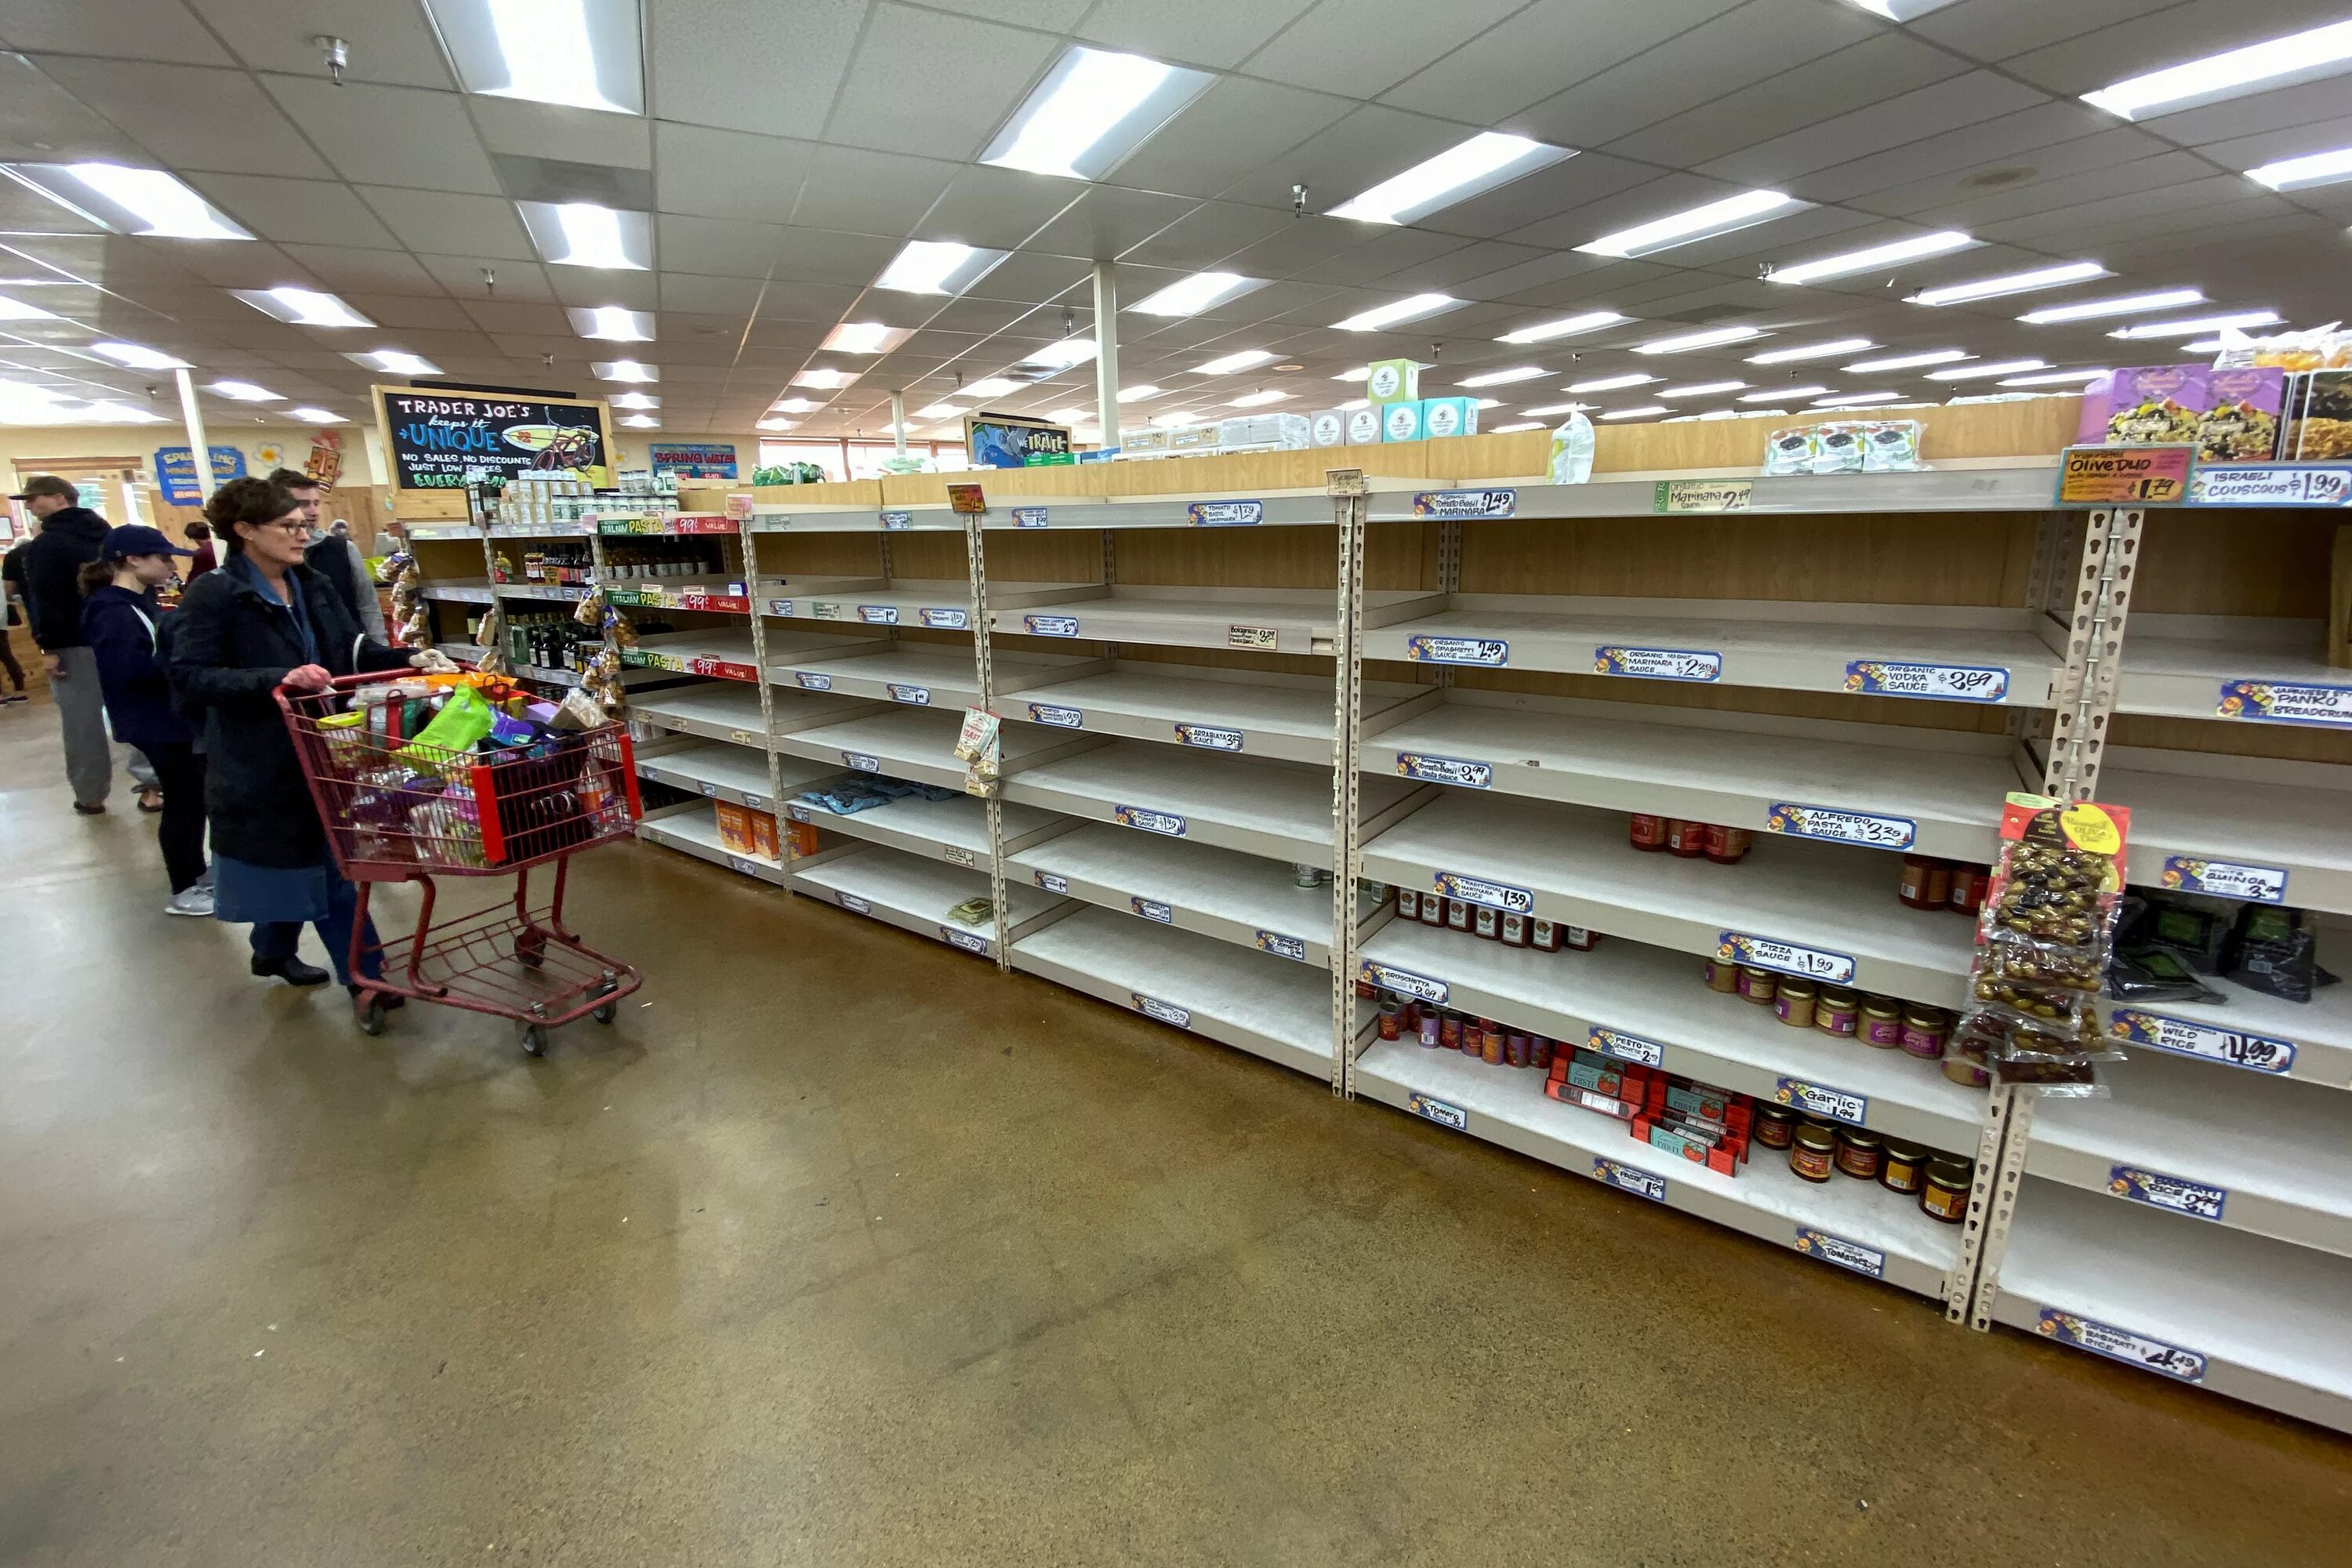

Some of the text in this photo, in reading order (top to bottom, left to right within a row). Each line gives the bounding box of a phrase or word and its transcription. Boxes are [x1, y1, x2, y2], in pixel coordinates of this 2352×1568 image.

[397, 401, 530, 418] TRADER JOE'S
[428, 415, 492, 430] keeps it
[408, 423, 501, 452] UNIQUE
[1017, 437, 1028, 448] WE
[463, 455, 477, 463] NO
[480, 456, 532, 465] DISCOUNTS
[654, 452, 703, 463] SPRING
[408, 463, 463, 473] JUST LOW
[2070, 459, 2114, 471] Olive
[2214, 472, 2273, 482] ISRAELI
[1670, 482, 1704, 492] Organic
[2209, 485, 2288, 496] COUSCOUS
[1671, 492, 1722, 503] Marinara
[601, 523, 628, 534] ITALIAN
[629, 520, 665, 533] PASTA
[612, 595, 639, 604] ITALIAN
[640, 593, 678, 608] PASTA
[1435, 641, 1501, 658] SPAGHETTI 2.49
[647, 654, 684, 672] PASTA
[1887, 666, 1936, 674] ORGANIC
[1889, 673, 1927, 682] VODKA
[1889, 682, 1929, 691] SAUCE
[2278, 694, 2338, 706] PANKO
[1193, 729, 1226, 740] ARRABIATA
[1421, 770, 1437, 779] Pasta
[1440, 764, 1457, 775] Basil
[1810, 811, 1871, 825] ALFREDO
[1807, 820, 1842, 829] PASTA
[1810, 828, 1847, 837] SAUCE
[2206, 873, 2267, 886] QUINOA
[1460, 879, 1502, 893] TRADITIONAL
[1461, 885, 1494, 895] MARINARA
[1461, 890, 1483, 899] SAUCE
[1761, 942, 1793, 956] PIZZA
[1755, 950, 1791, 962] SAUCE
[2163, 1026, 2198, 1039] WILD
[1615, 1036, 1642, 1049] PESTO
[2161, 1036, 2196, 1049] RICE
[1805, 1091, 1857, 1109] Garlic
[1428, 1105, 1460, 1120] TOMATO
[2147, 1183, 2183, 1196] RICE
[1825, 1247, 1869, 1267] TOMATOES
[2085, 1330, 2136, 1350] BASMATI
[2085, 1338, 2114, 1352] RICE
